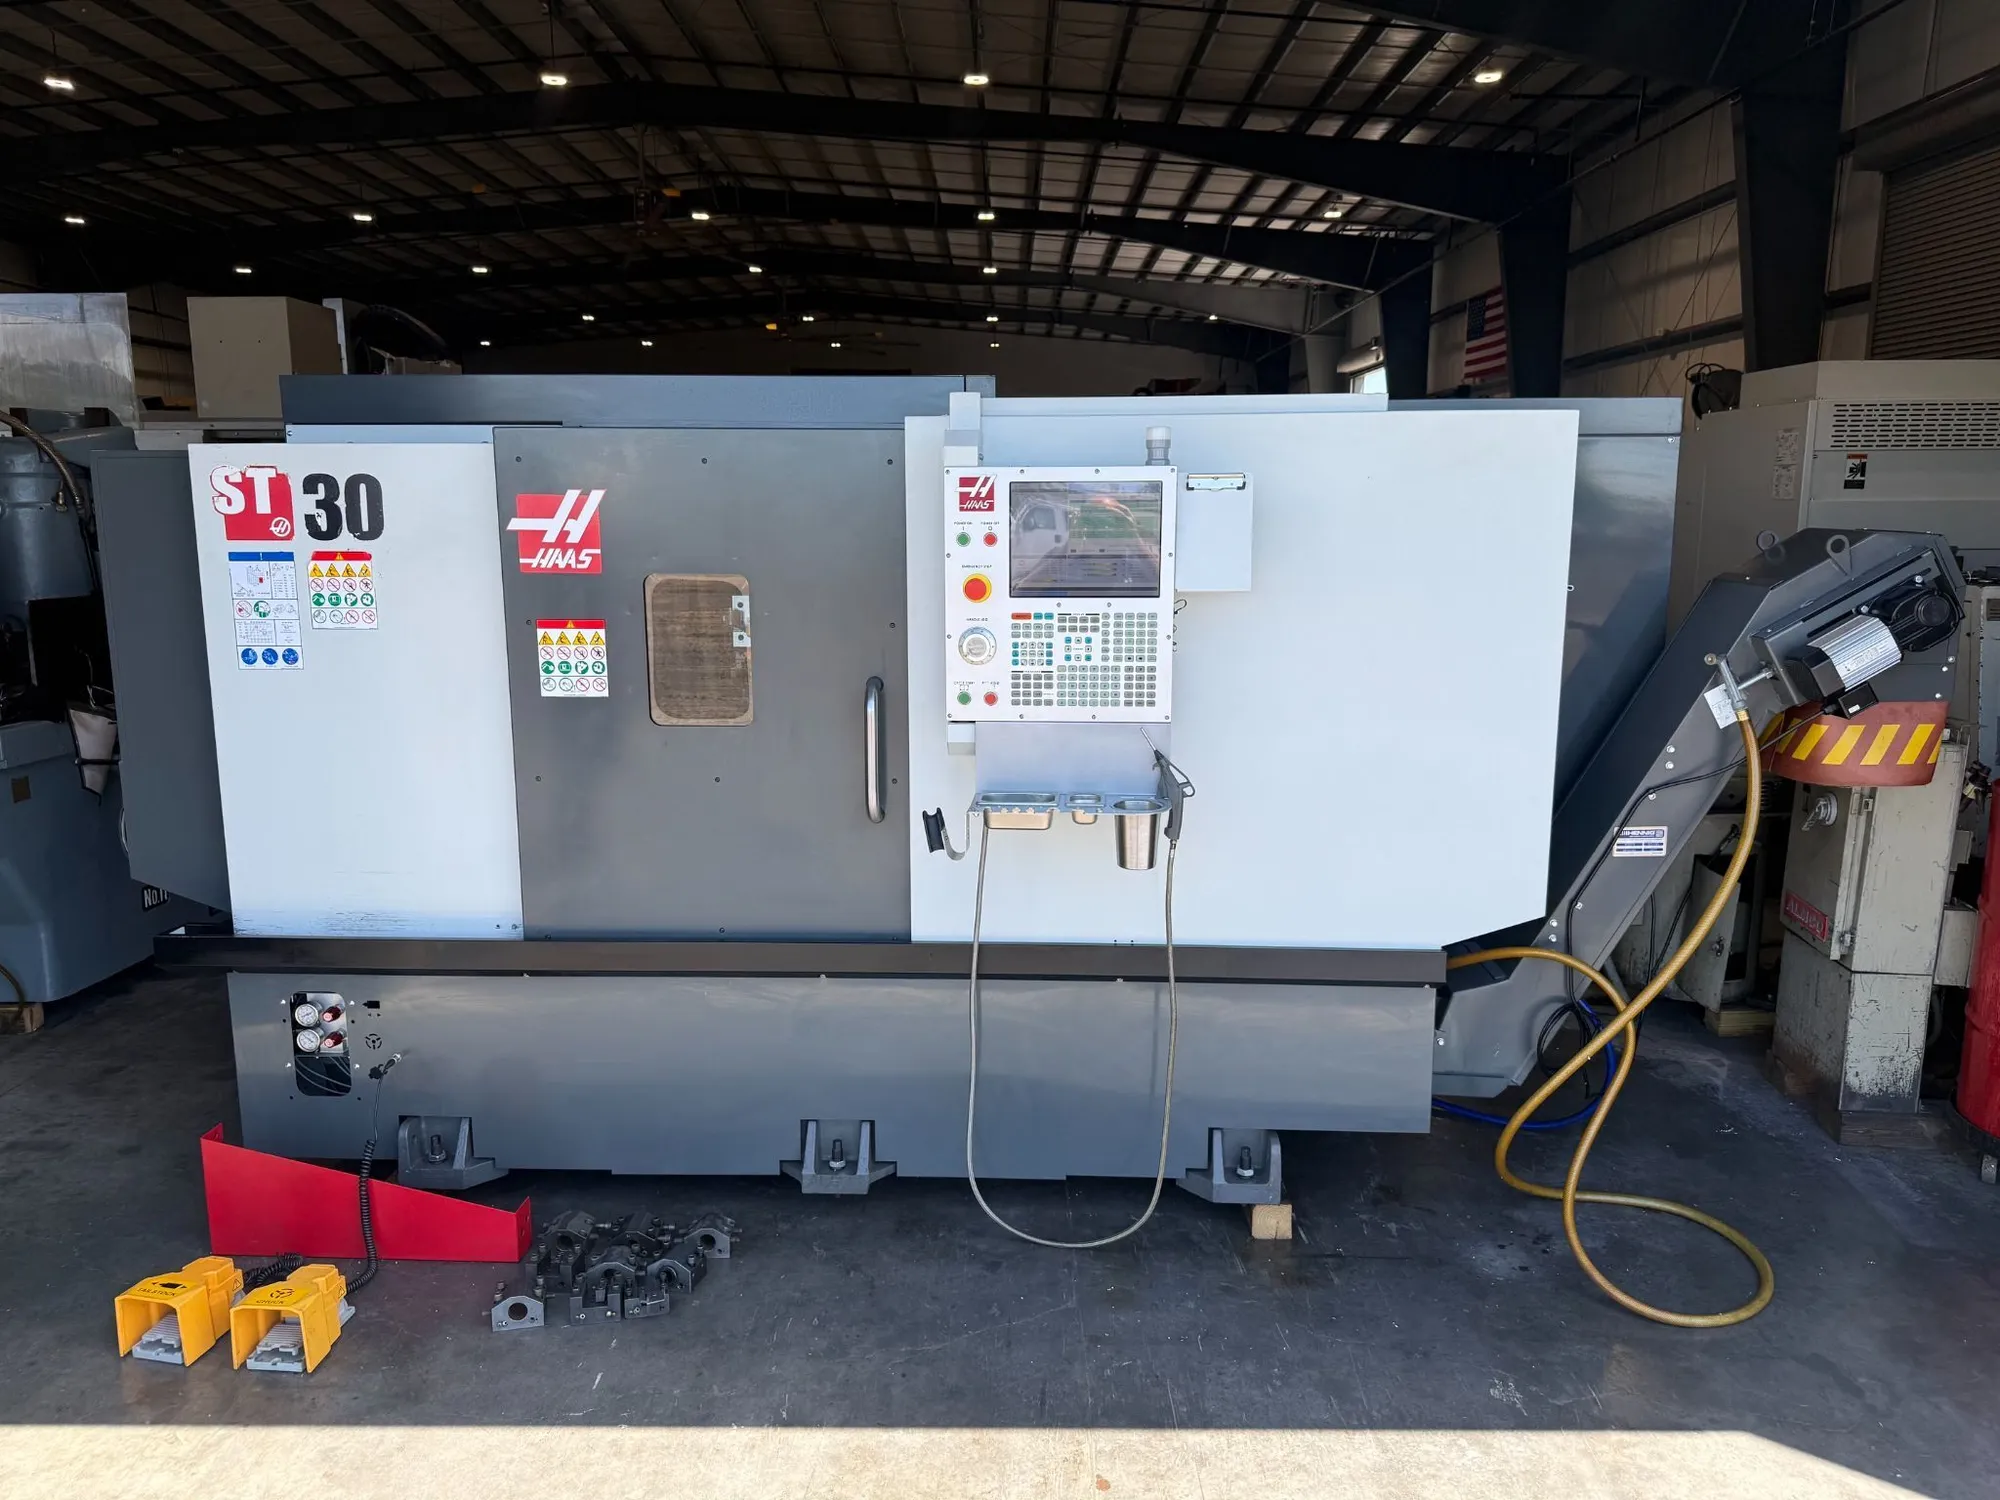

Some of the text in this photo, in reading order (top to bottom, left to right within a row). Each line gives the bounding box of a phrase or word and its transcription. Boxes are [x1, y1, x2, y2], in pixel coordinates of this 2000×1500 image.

[211, 466, 385, 541] ST 30
[959, 499, 994, 510] HAAS
[519, 548, 601, 569] HAAS
